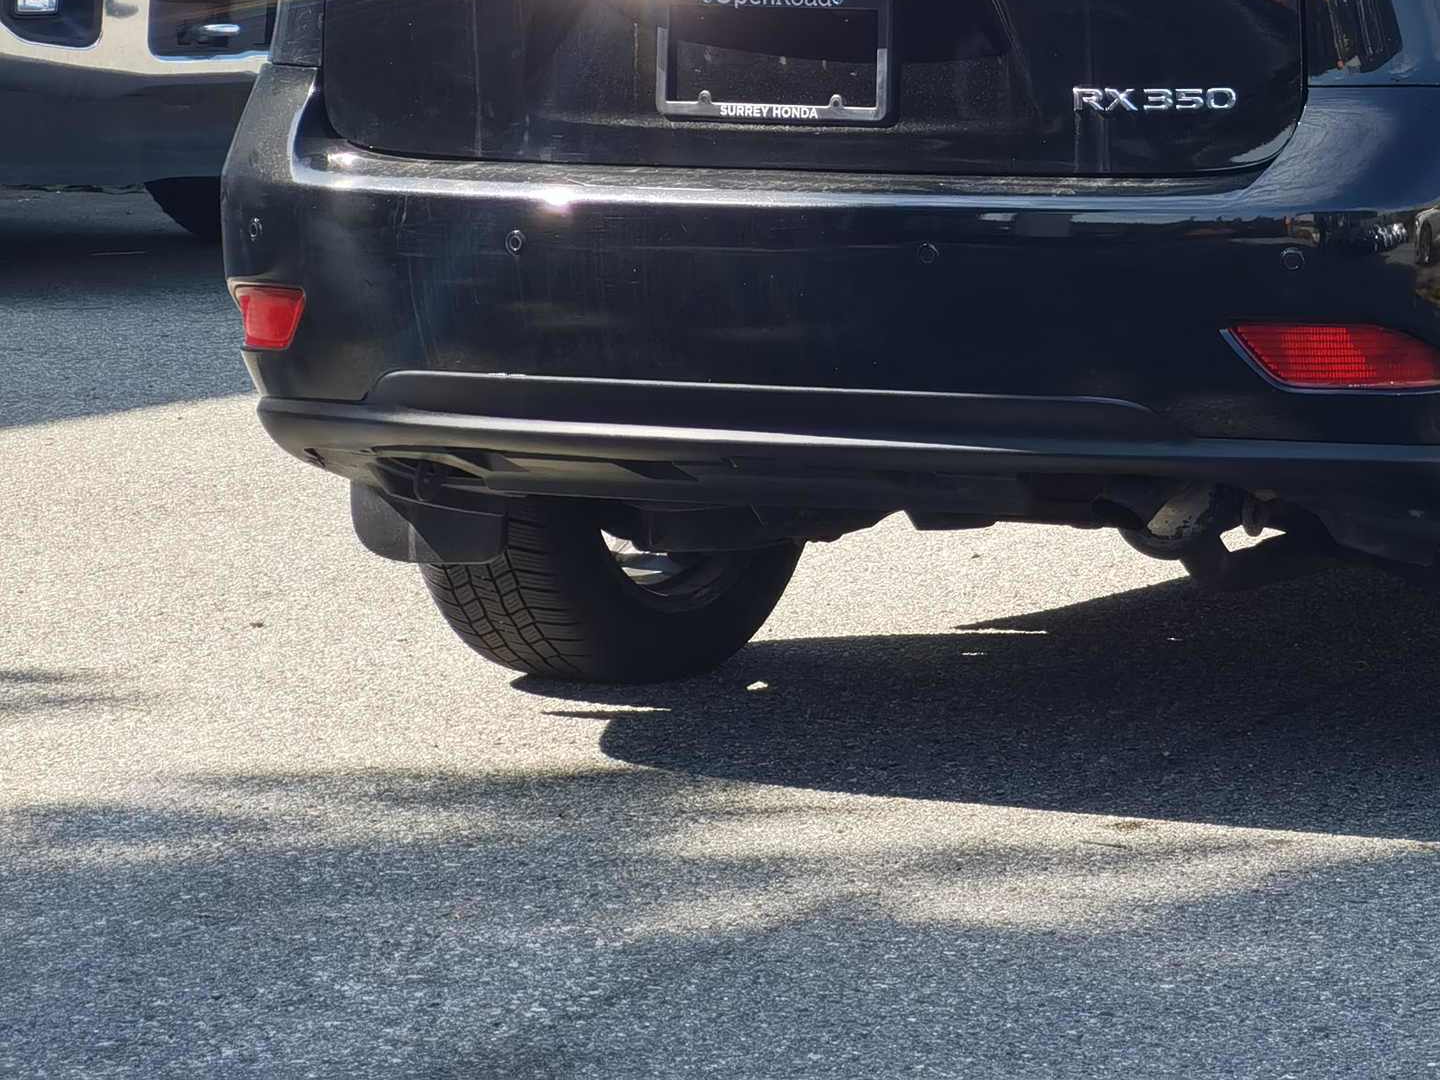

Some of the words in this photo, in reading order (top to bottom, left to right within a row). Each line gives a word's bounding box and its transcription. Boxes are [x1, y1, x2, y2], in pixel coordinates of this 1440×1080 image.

[1072, 87, 1138, 111] RX
[1143, 87, 1237, 111] 350
[720, 104, 769, 118] SURREY
[772, 105, 818, 119] HONDA
